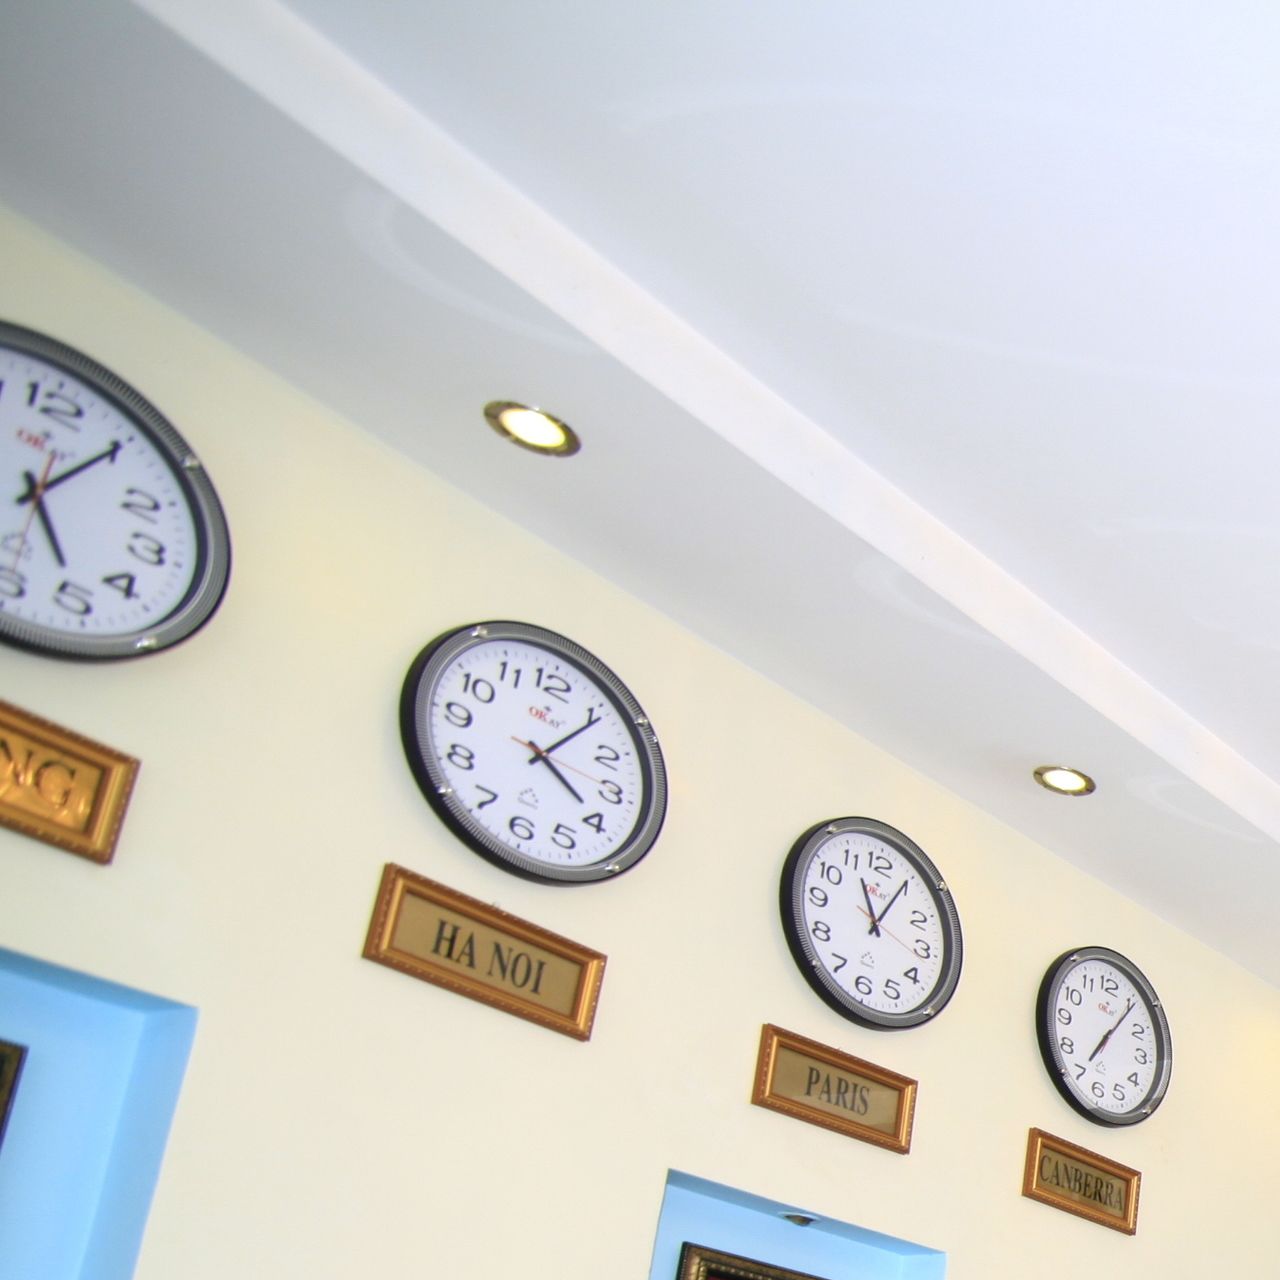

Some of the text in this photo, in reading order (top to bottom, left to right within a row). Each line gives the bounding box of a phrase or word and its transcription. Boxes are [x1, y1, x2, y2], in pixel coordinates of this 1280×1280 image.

[27, 382, 84, 432] 12
[120, 488, 161, 525] 2
[127, 532, 166, 566] 3
[53, 580, 94, 615] 5
[102, 572, 140, 600] 4
[500, 661, 521, 689] 11
[535, 667, 572, 704] 12
[463, 672, 495, 704] 10
[444, 701, 473, 728] 9
[447, 743, 475, 771] 8
[594, 744, 620, 771] 2
[475, 784, 498, 810] 7
[598, 779, 623, 805] 3
[508, 816, 535, 841] 6
[582, 812, 606, 834] 4
[551, 823, 577, 850] 5
[844, 849, 859, 871] 11
[868, 851, 894, 879] 12
[820, 861, 842, 886] 10
[809, 887, 828, 908] 9
[812, 920, 831, 942] 8
[910, 910, 927, 932] 2
[432, 919, 547, 995] HA NOI
[913, 939, 931, 959] 3
[832, 953, 848, 973] 7
[855, 975, 873, 995] 6
[903, 967, 920, 985] 4
[1082, 974, 1094, 992] 11
[1100, 975, 1119, 998] 12
[883, 979, 900, 1001] 5
[1065, 985, 1082, 1006] 10
[1057, 1007, 1072, 1026] 9
[1131, 1023, 1145, 1041] 2
[1060, 1036, 1074, 1055] 8
[1134, 1048, 1148, 1065] 3
[1074, 1063, 1087, 1081] 7
[1127, 1072, 1140, 1087] 4
[804, 1066, 870, 1116] PARIS
[1091, 1081, 1105, 1098] 6
[1112, 1083, 1126, 1101] 5
[1040, 1154, 1123, 1211] CANBERRA
